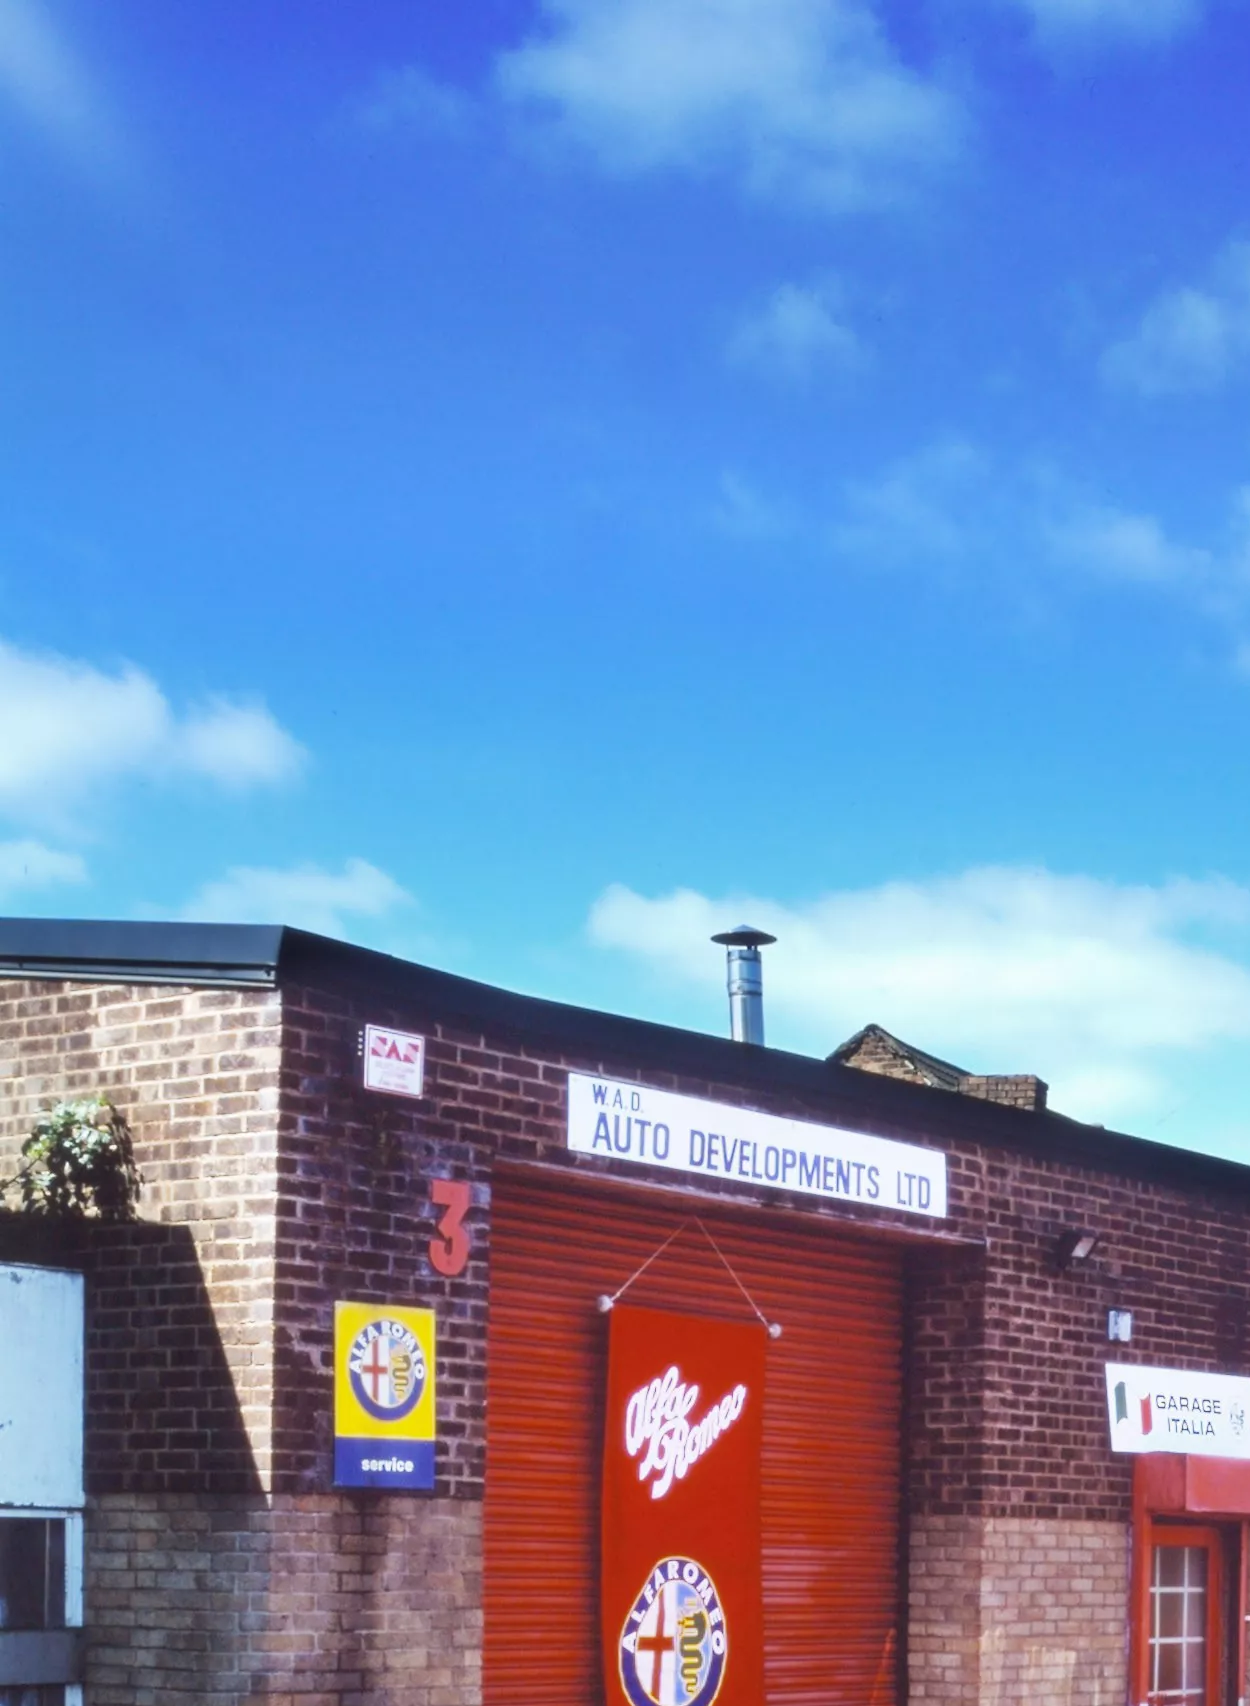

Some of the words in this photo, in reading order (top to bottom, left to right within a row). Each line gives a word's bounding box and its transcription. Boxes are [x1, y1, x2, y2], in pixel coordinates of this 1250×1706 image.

[592, 1112, 670, 1160] AUTO
[689, 1129, 880, 1199] DEVELOPMENTS
[897, 1171, 931, 1210] LTD
[430, 1180, 470, 1276] 3
[350, 1325, 380, 1374] ALFA
[380, 1320, 425, 1380] ROMEO
[626, 1366, 699, 1456] Alfa
[639, 1384, 747, 1499] Romeo
[1156, 1395, 1222, 1415] GARAGE
[1167, 1417, 1216, 1436] ITALIA
[361, 1457, 414, 1473] service
[622, 1568, 665, 1654] ALFA
[667, 1560, 725, 1655] ROMEO
